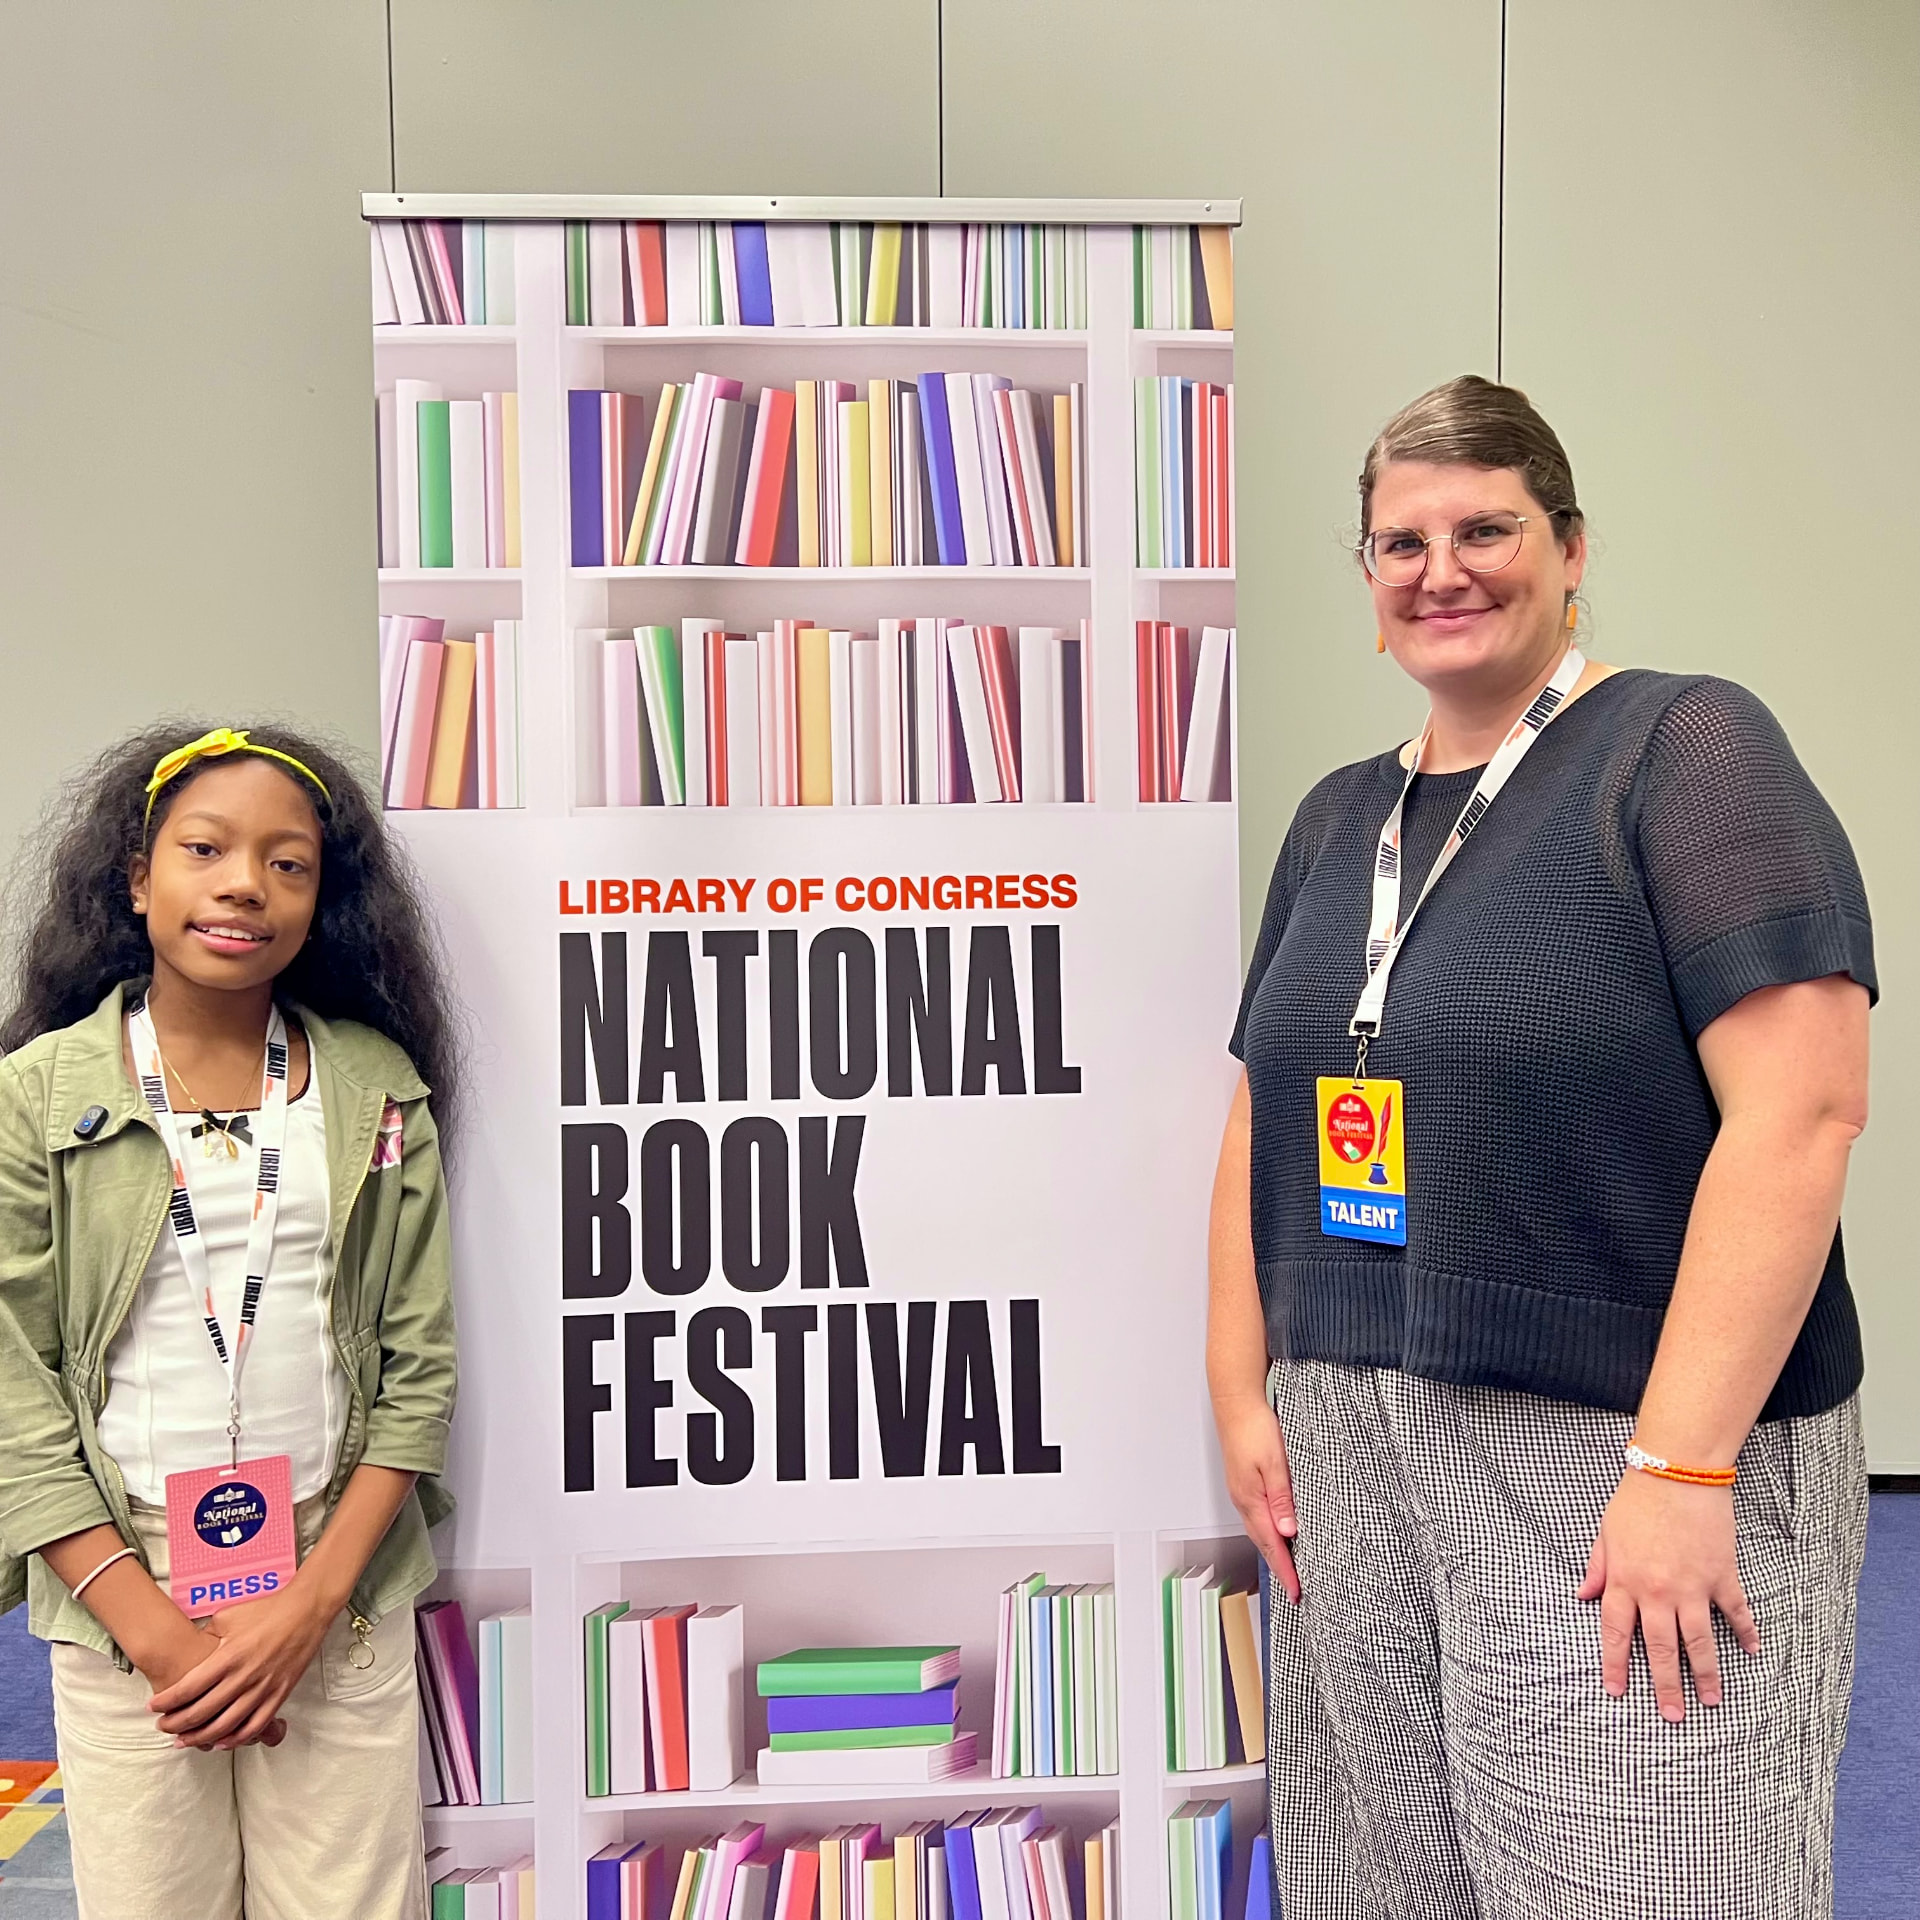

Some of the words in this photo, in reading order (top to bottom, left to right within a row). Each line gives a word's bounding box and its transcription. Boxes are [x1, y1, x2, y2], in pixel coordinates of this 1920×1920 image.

[1521, 686, 1565, 733] LIBRARY
[1456, 791, 1490, 841] LIBRARY
[1378, 841, 1399, 879] LIBRARY
[559, 878, 756, 914] LIBRARY
[767, 878, 824, 913] OF
[835, 874, 1078, 912] CONGRESS
[559, 925, 1082, 1106] NATIONAL
[267, 1042, 287, 1080] LIBRARY
[141, 1075, 169, 1113] LIBRARY
[257, 1148, 280, 1194] LIBRARY
[169, 1187, 197, 1238] LIBRARY
[562, 1115, 870, 1299] BOOK
[1327, 1201, 1399, 1230] TALENT
[241, 1275, 264, 1326] LIBRARY
[204, 1316, 229, 1364] LIBRARY
[563, 1298, 1062, 1493] FESTIVAL
[203, 1502, 257, 1521] National
[190, 1572, 279, 1605] PRESS
